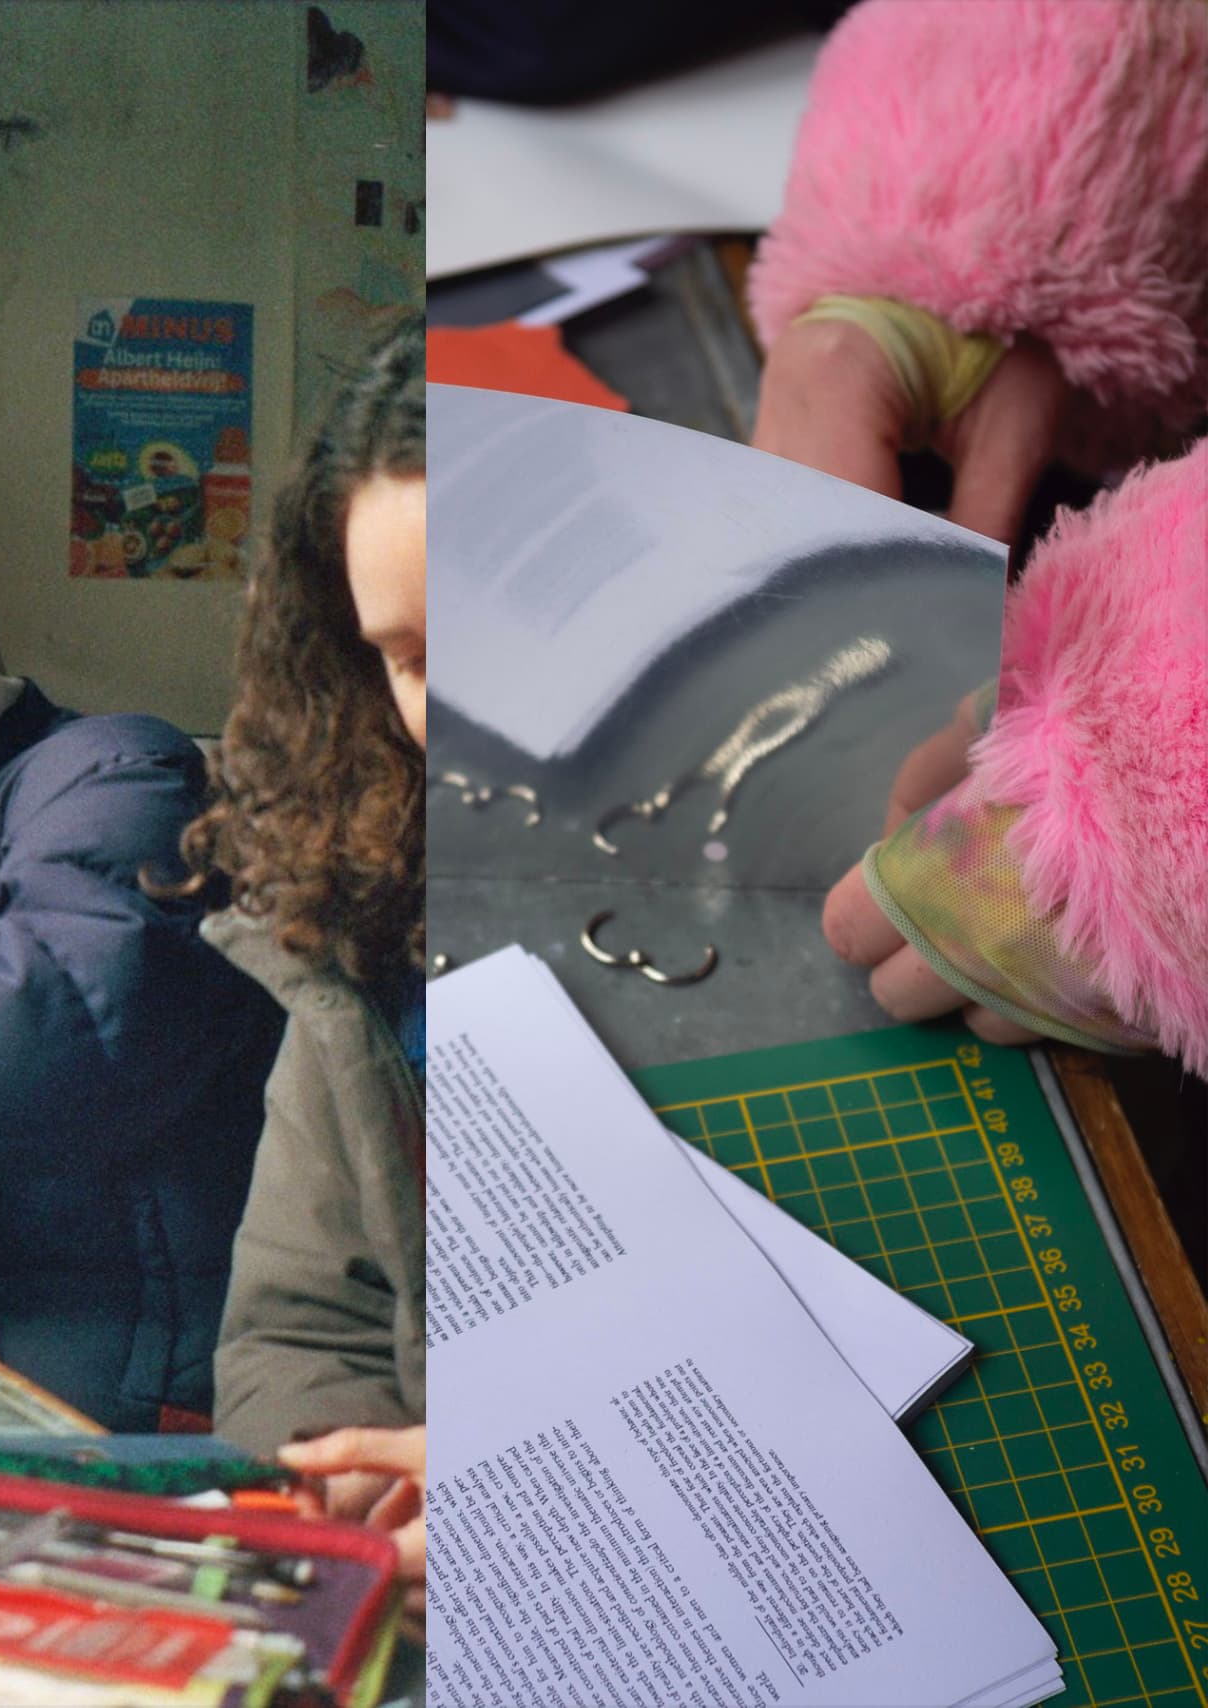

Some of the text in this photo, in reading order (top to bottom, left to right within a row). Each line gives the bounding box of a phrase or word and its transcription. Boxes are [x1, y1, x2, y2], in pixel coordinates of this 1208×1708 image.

[120, 314, 235, 343] MINUS
[103, 349, 162, 367] Albert
[956, 1043, 982, 1068] 42
[970, 1077, 995, 1100] 41
[983, 1108, 1009, 1133] 40
[997, 1142, 1024, 1168] 39
[1010, 1176, 1038, 1202] 38
[445, 1213, 468, 1236] their
[1024, 1213, 1052, 1238] 37
[427, 1237, 451, 1264] others
[442, 1233, 461, 1252] The
[459, 1233, 481, 1256] from
[464, 1188, 540, 1289] This movement of inquiry
[472, 1252, 502, 1283] beings
[1038, 1248, 1067, 1275] 36
[442, 1260, 474, 1295] prevent
[476, 1286, 493, 1300] of
[490, 1280, 518, 1311] human
[511, 1284, 532, 1304] into
[1053, 1284, 1082, 1312] 35
[488, 1298, 504, 1316] one
[1068, 1323, 1097, 1350] 34
[1083, 1361, 1113, 1390] 33
[607, 1395, 622, 1408] al-
[1099, 1400, 1128, 1431] 32
[518, 1438, 537, 1456] the
[532, 1430, 555, 1452] (the
[546, 1424, 571, 1451] intro-
[635, 1436, 650, 1448] of
[527, 1452, 544, 1467] of
[562, 1448, 578, 1462] to
[642, 1444, 664, 1464] type
[1116, 1444, 1146, 1472] 31
[544, 1448, 577, 1488] universe
[569, 1456, 601, 1490] begins
[654, 1462, 672, 1479] this
[461, 1465, 494, 1503] analysis
[535, 1463, 585, 1523] investigation
[592, 1487, 605, 1499] or
[568, 1485, 603, 1526] thematic
[664, 1477, 703, 1524] demonstrate
[793, 1487, 824, 1522] primary
[1132, 1484, 1163, 1515] 30
[483, 1500, 512, 1535] critical
[572, 1519, 592, 1538] the
[596, 1498, 636, 1547] introduces
[507, 1532, 517, 1541] a
[593, 1522, 632, 1569] minimum
[695, 1521, 717, 1544] often
[815, 1518, 850, 1557] assigning
[1149, 1527, 1181, 1559] 29
[513, 1540, 533, 1561] way,
[560, 1417, 768, 1708] duce women and men to a critical form of thinking about their
[627, 1544, 650, 1567] thus
[709, 1541, 730, 1562] class
[522, 1560, 543, 1582] this
[582, 1533, 641, 1607] conscientização
[623, 1566, 643, 1586] the
[722, 1560, 749, 1590] middle
[840, 1554, 862, 1577] been
[450, 1472, 607, 1708] are constituted of parts in interaction, should be per-
[493, 1451, 666, 1708] towards the limit-situations. The perception and compre-
[534, 1580, 551, 1595] In
[634, 1583, 651, 1597] in
[641, 1563, 688, 1620] interaction)
[855, 1575, 874, 1594] had
[1166, 1571, 1199, 1604] 28
[543, 1592, 576, 1628] reality.
[742, 1588, 760, 1605] the
[751, 1602, 767, 1615] of
[867, 1590, 890, 1612] they
[628, 1604, 646, 1619] of
[641, 1593, 682, 1643] contained
[676, 1617, 693, 1631] in
[880, 1609, 906, 1637] which
[564, 1625, 588, 1651] total
[637, 1615, 690, 1682] methodology
[684, 1628, 718, 1667] themes
[759, 1612, 798, 1660] Individuals
[431, 1602, 504, 1707] for the methodology of
[578, 1647, 596, 1663] of
[673, 1640, 703, 1675] theme
[447, 1659, 475, 1694] whole.
[683, 1680, 694, 1689] a
[752, 1670, 782, 1704] world.
